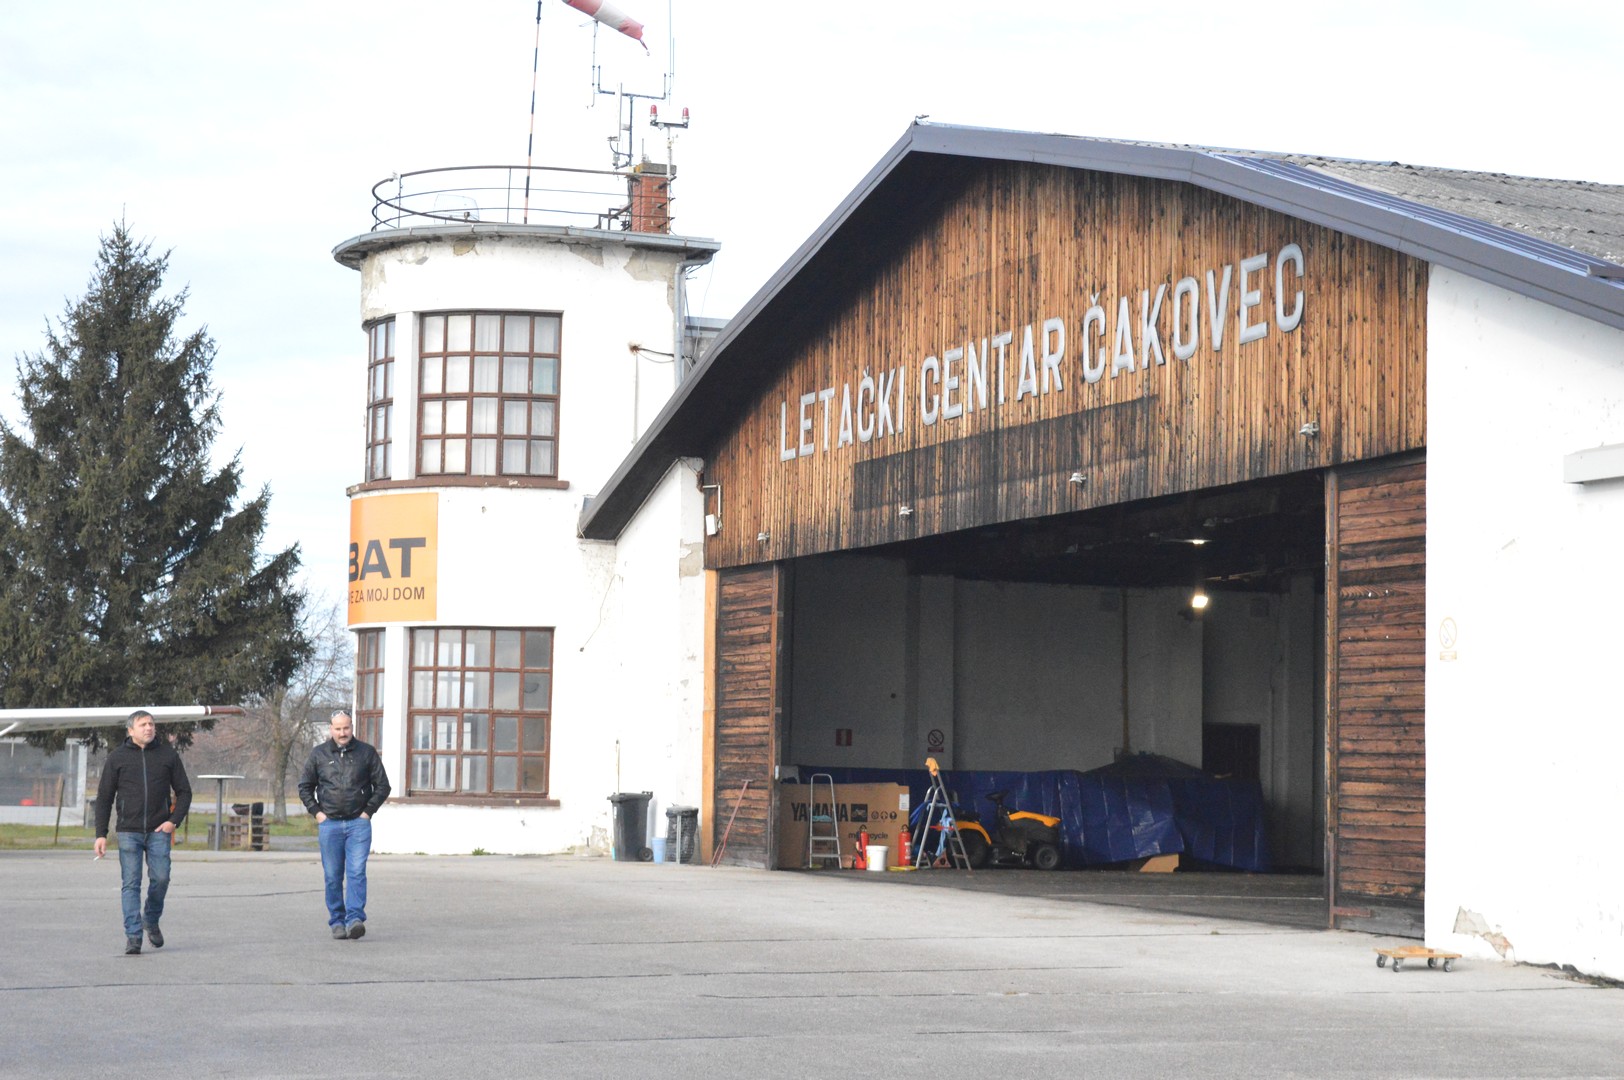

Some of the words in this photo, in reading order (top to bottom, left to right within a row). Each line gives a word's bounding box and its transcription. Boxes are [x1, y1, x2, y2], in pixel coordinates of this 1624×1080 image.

[780, 365, 905, 462] LETAČKI
[920, 316, 1065, 426] CENTAR
[1082, 243, 1305, 384] ČAKOVEC
[355, 589, 364, 604] ZA
[366, 587, 389, 602] MOJ
[393, 586, 425, 601] DOM
